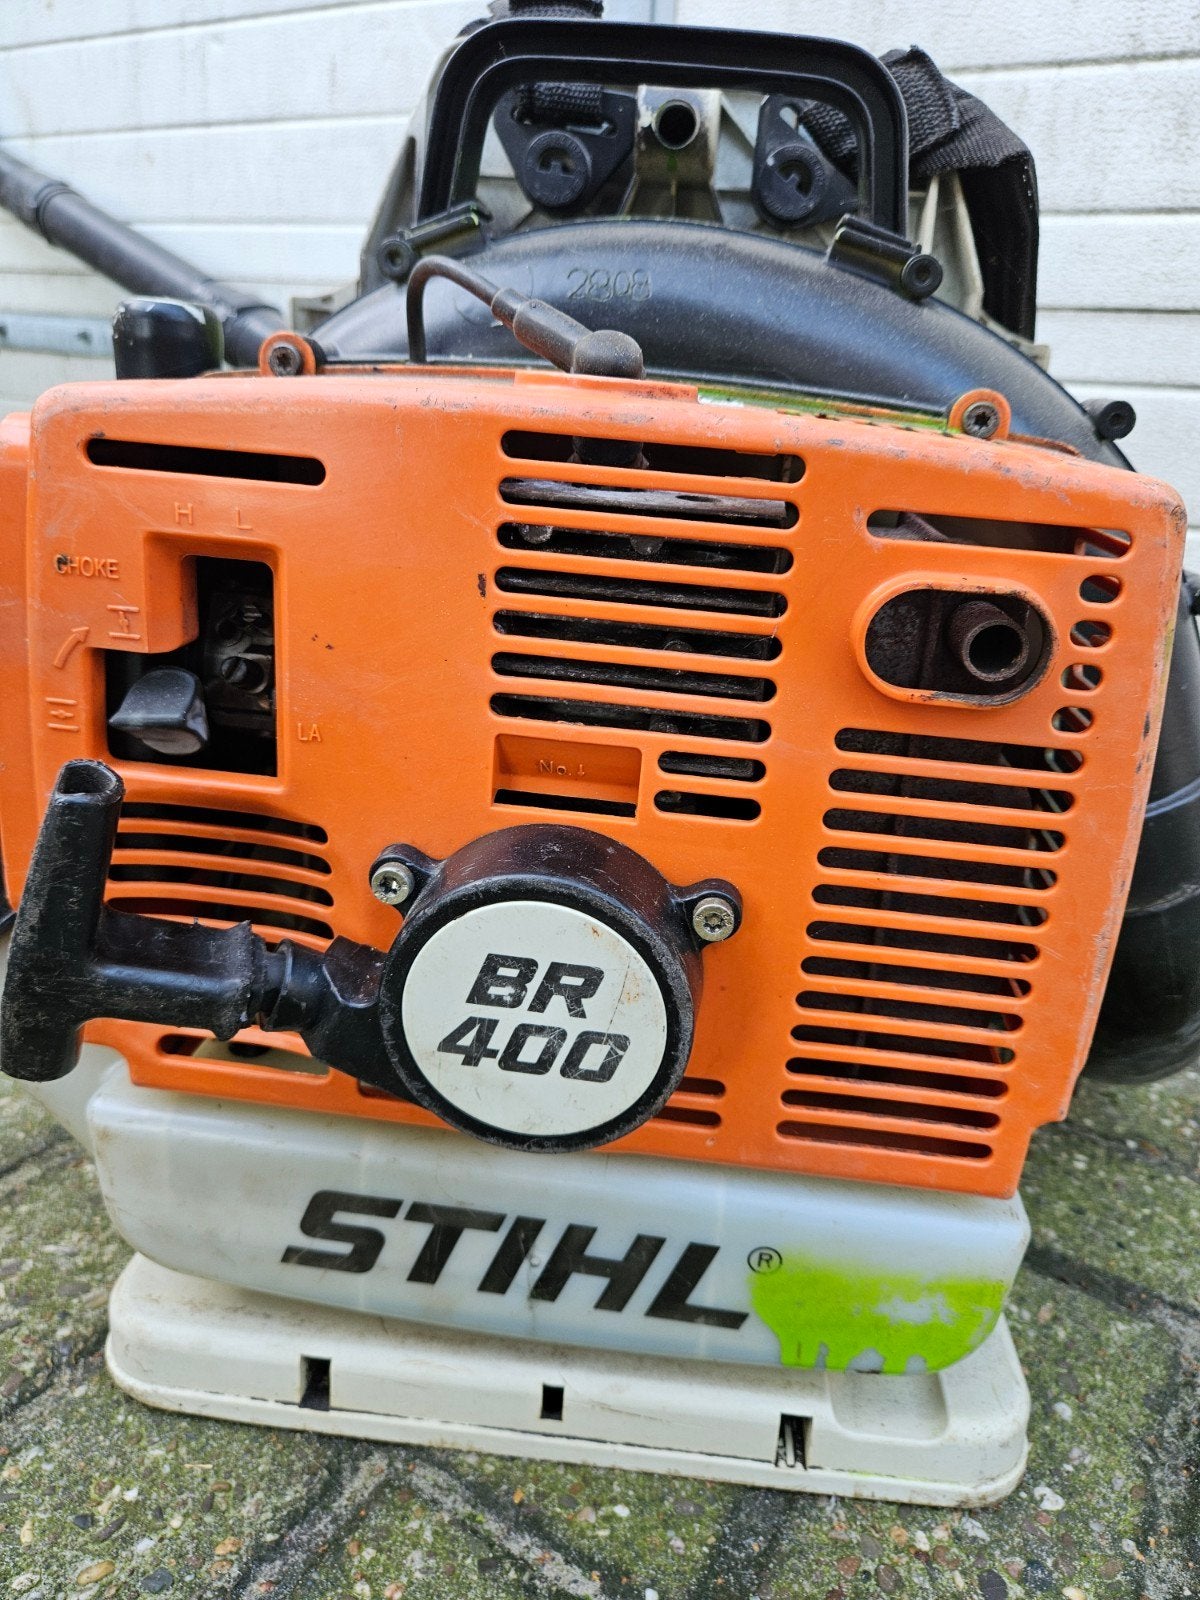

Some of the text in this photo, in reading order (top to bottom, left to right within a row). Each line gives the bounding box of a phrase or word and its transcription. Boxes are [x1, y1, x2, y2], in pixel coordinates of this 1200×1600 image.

[174, 502, 253, 530] H L
[55, 554, 120, 579] CHOKE
[297, 722, 321, 742] LA
[465, 952, 605, 1019] BR
[436, 1015, 631, 1083] 400
[280, 1189, 749, 1330] STIHL
